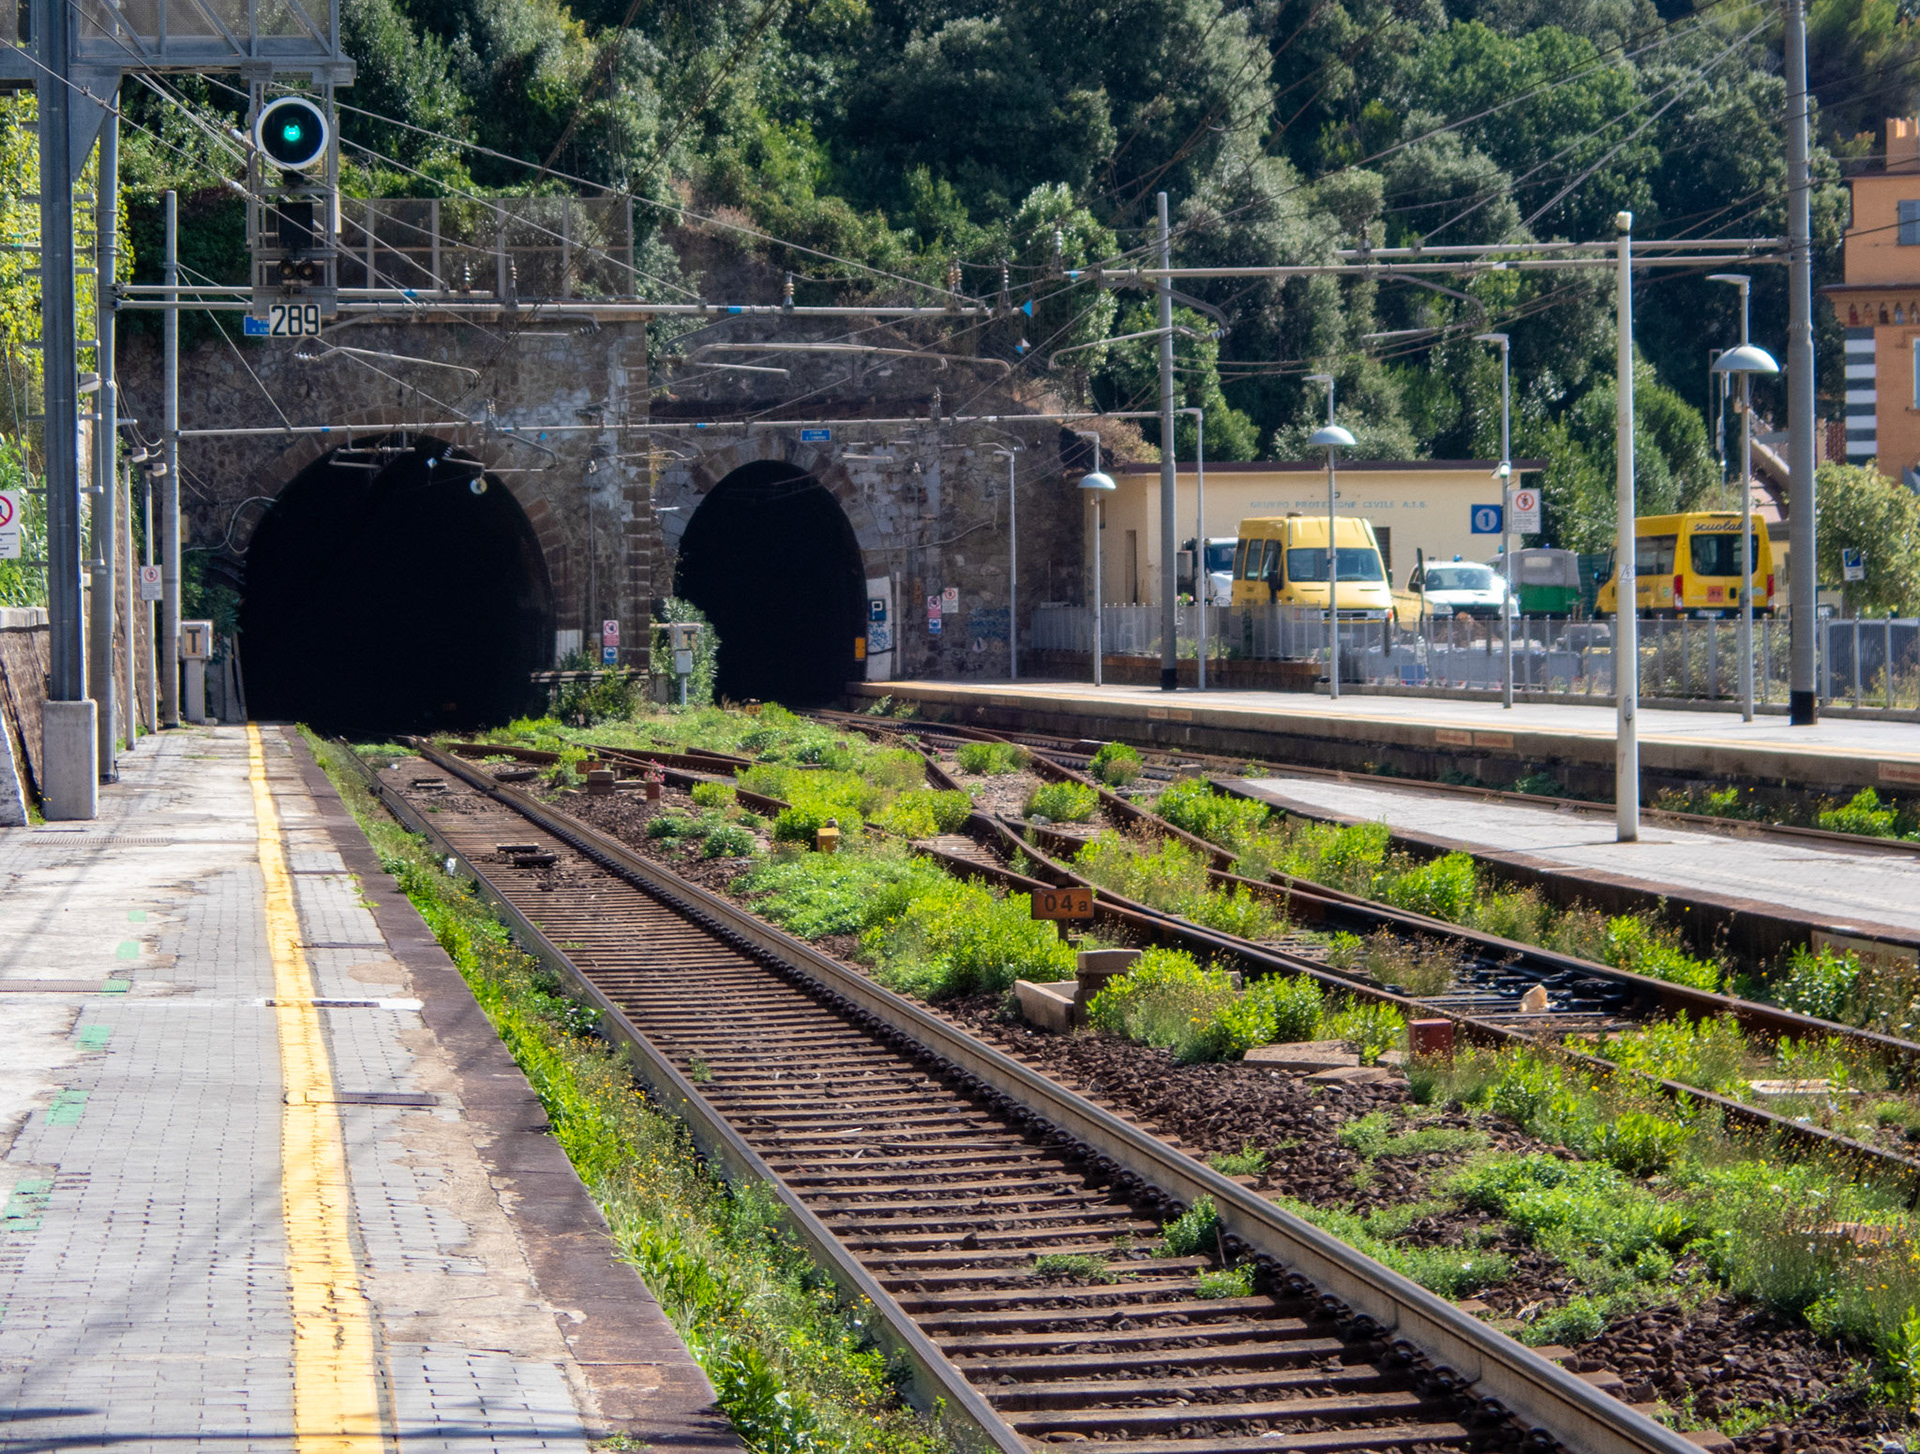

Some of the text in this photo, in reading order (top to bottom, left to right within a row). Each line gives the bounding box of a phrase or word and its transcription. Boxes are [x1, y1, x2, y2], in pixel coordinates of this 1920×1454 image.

[271, 305, 318, 335] 289
[1482, 512, 1489, 527] 1
[187, 629, 200, 653] T
